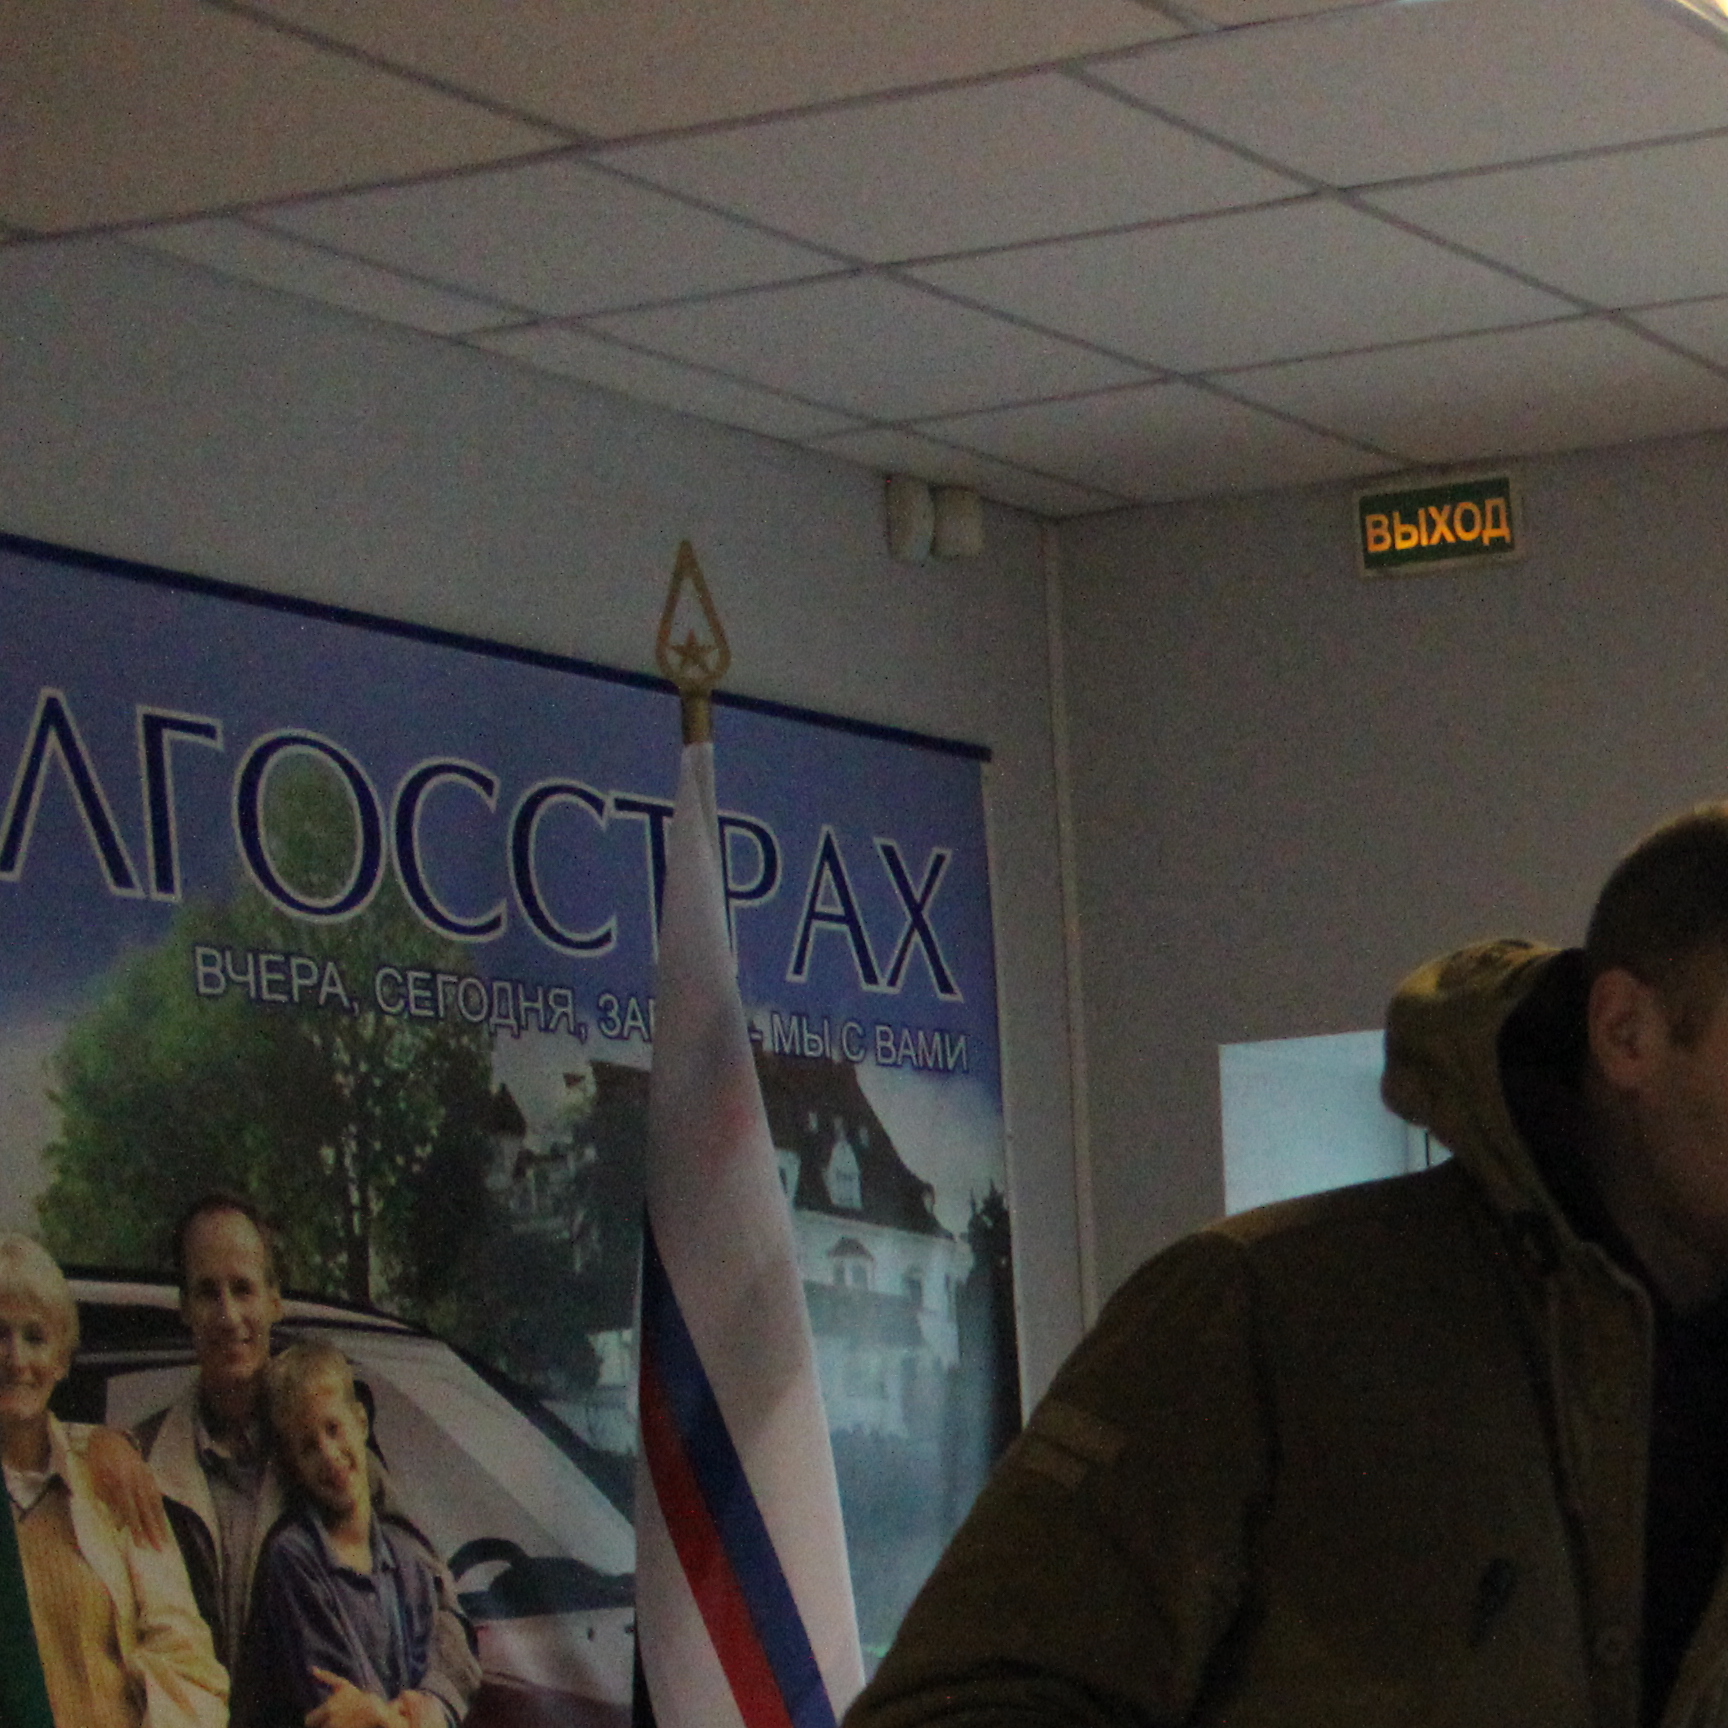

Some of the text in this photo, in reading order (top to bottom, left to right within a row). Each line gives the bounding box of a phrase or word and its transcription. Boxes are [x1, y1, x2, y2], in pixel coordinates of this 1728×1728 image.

[1366, 498, 1511, 553] ВЫХОД
[194, 945, 360, 1017] ВЧЕРА,
[374, 966, 588, 1045] СЕГОДНЯ,
[771, 1012, 832, 1058] МЫ
[841, 1020, 867, 1063] С
[875, 1024, 970, 1073] ВАМИ
